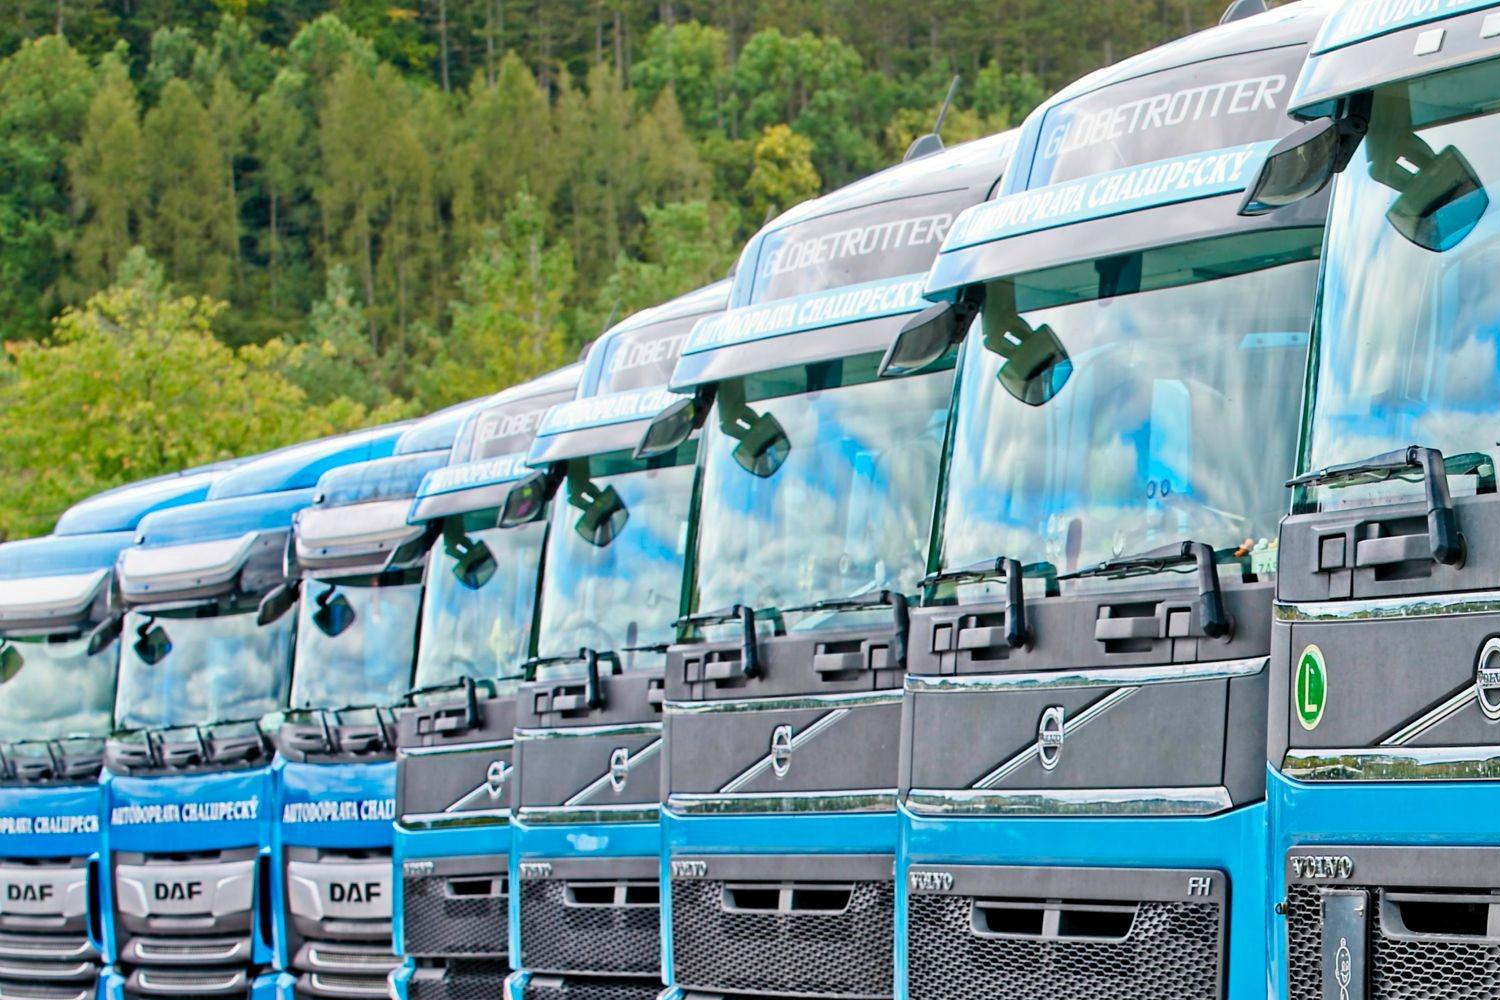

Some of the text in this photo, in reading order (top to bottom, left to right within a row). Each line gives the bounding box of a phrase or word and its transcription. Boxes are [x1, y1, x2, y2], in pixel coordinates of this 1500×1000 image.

[1043, 73, 1287, 159] GLOBETROTTER
[1088, 145, 1254, 210] CHALUPECKÝ
[763, 213, 954, 277] GLOBETROTTER
[1304, 663, 1317, 713] L
[34, 814, 100, 834] CHALUPECK
[1289, 855, 1355, 880] VOLVO
[154, 881, 203, 901] DAF
[910, 871, 954, 890] VOLVO
[1187, 876, 1212, 896] FH
[8, 883, 54, 901] DAF
[329, 882, 381, 903] DAF
